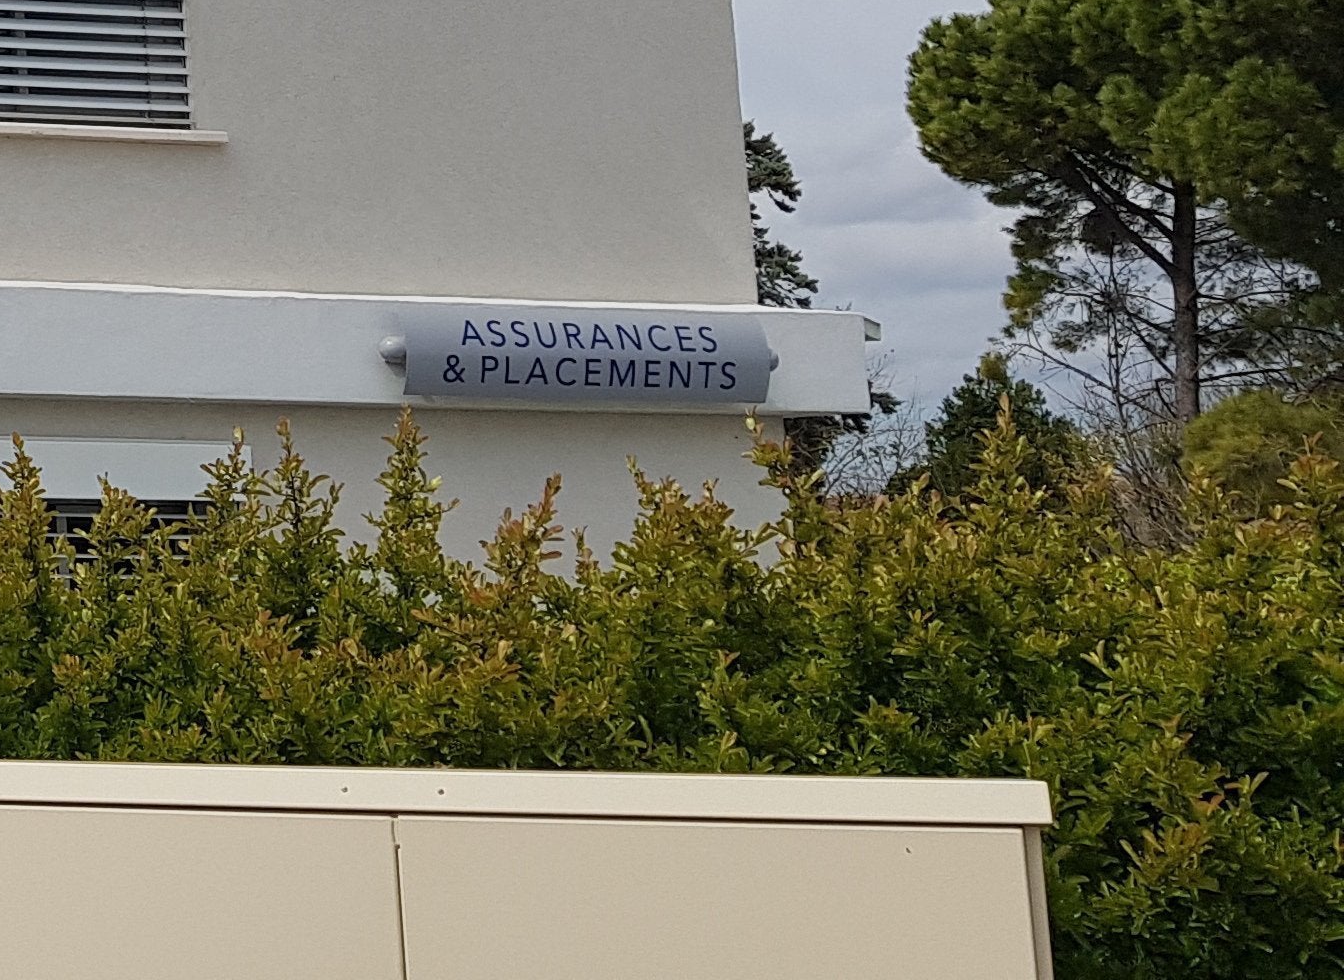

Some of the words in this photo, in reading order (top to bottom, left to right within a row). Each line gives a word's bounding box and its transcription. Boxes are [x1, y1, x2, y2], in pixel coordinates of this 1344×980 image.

[461, 319, 718, 353] ASSURANCES
[442, 354, 466, 383] &
[480, 355, 737, 390] PLACEMENTS
